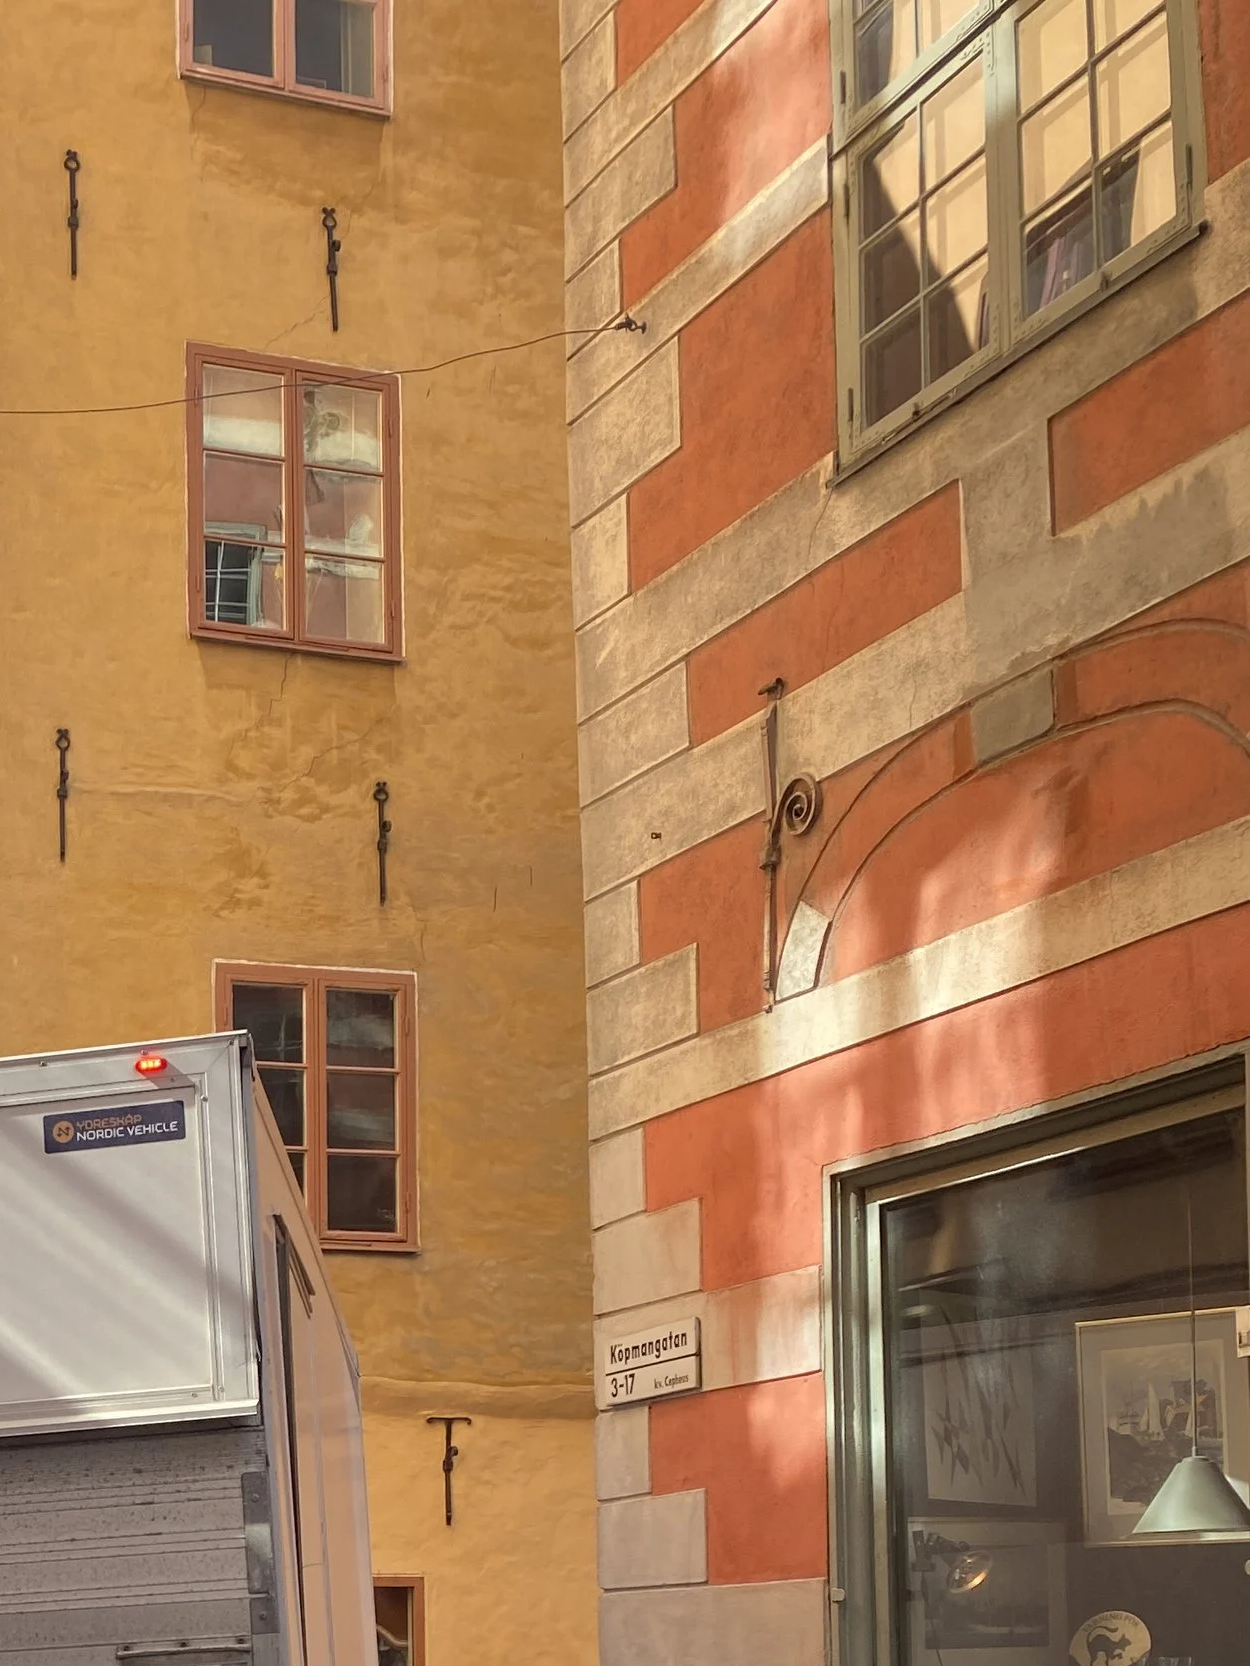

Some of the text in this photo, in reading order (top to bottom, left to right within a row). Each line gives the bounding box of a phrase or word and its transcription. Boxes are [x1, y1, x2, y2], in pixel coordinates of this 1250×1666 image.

[76, 1120, 179, 1142] NORDIC VEHICLE
[610, 1331, 688, 1365] Köpmangatan
[611, 1373, 635, 1398] 3-17
